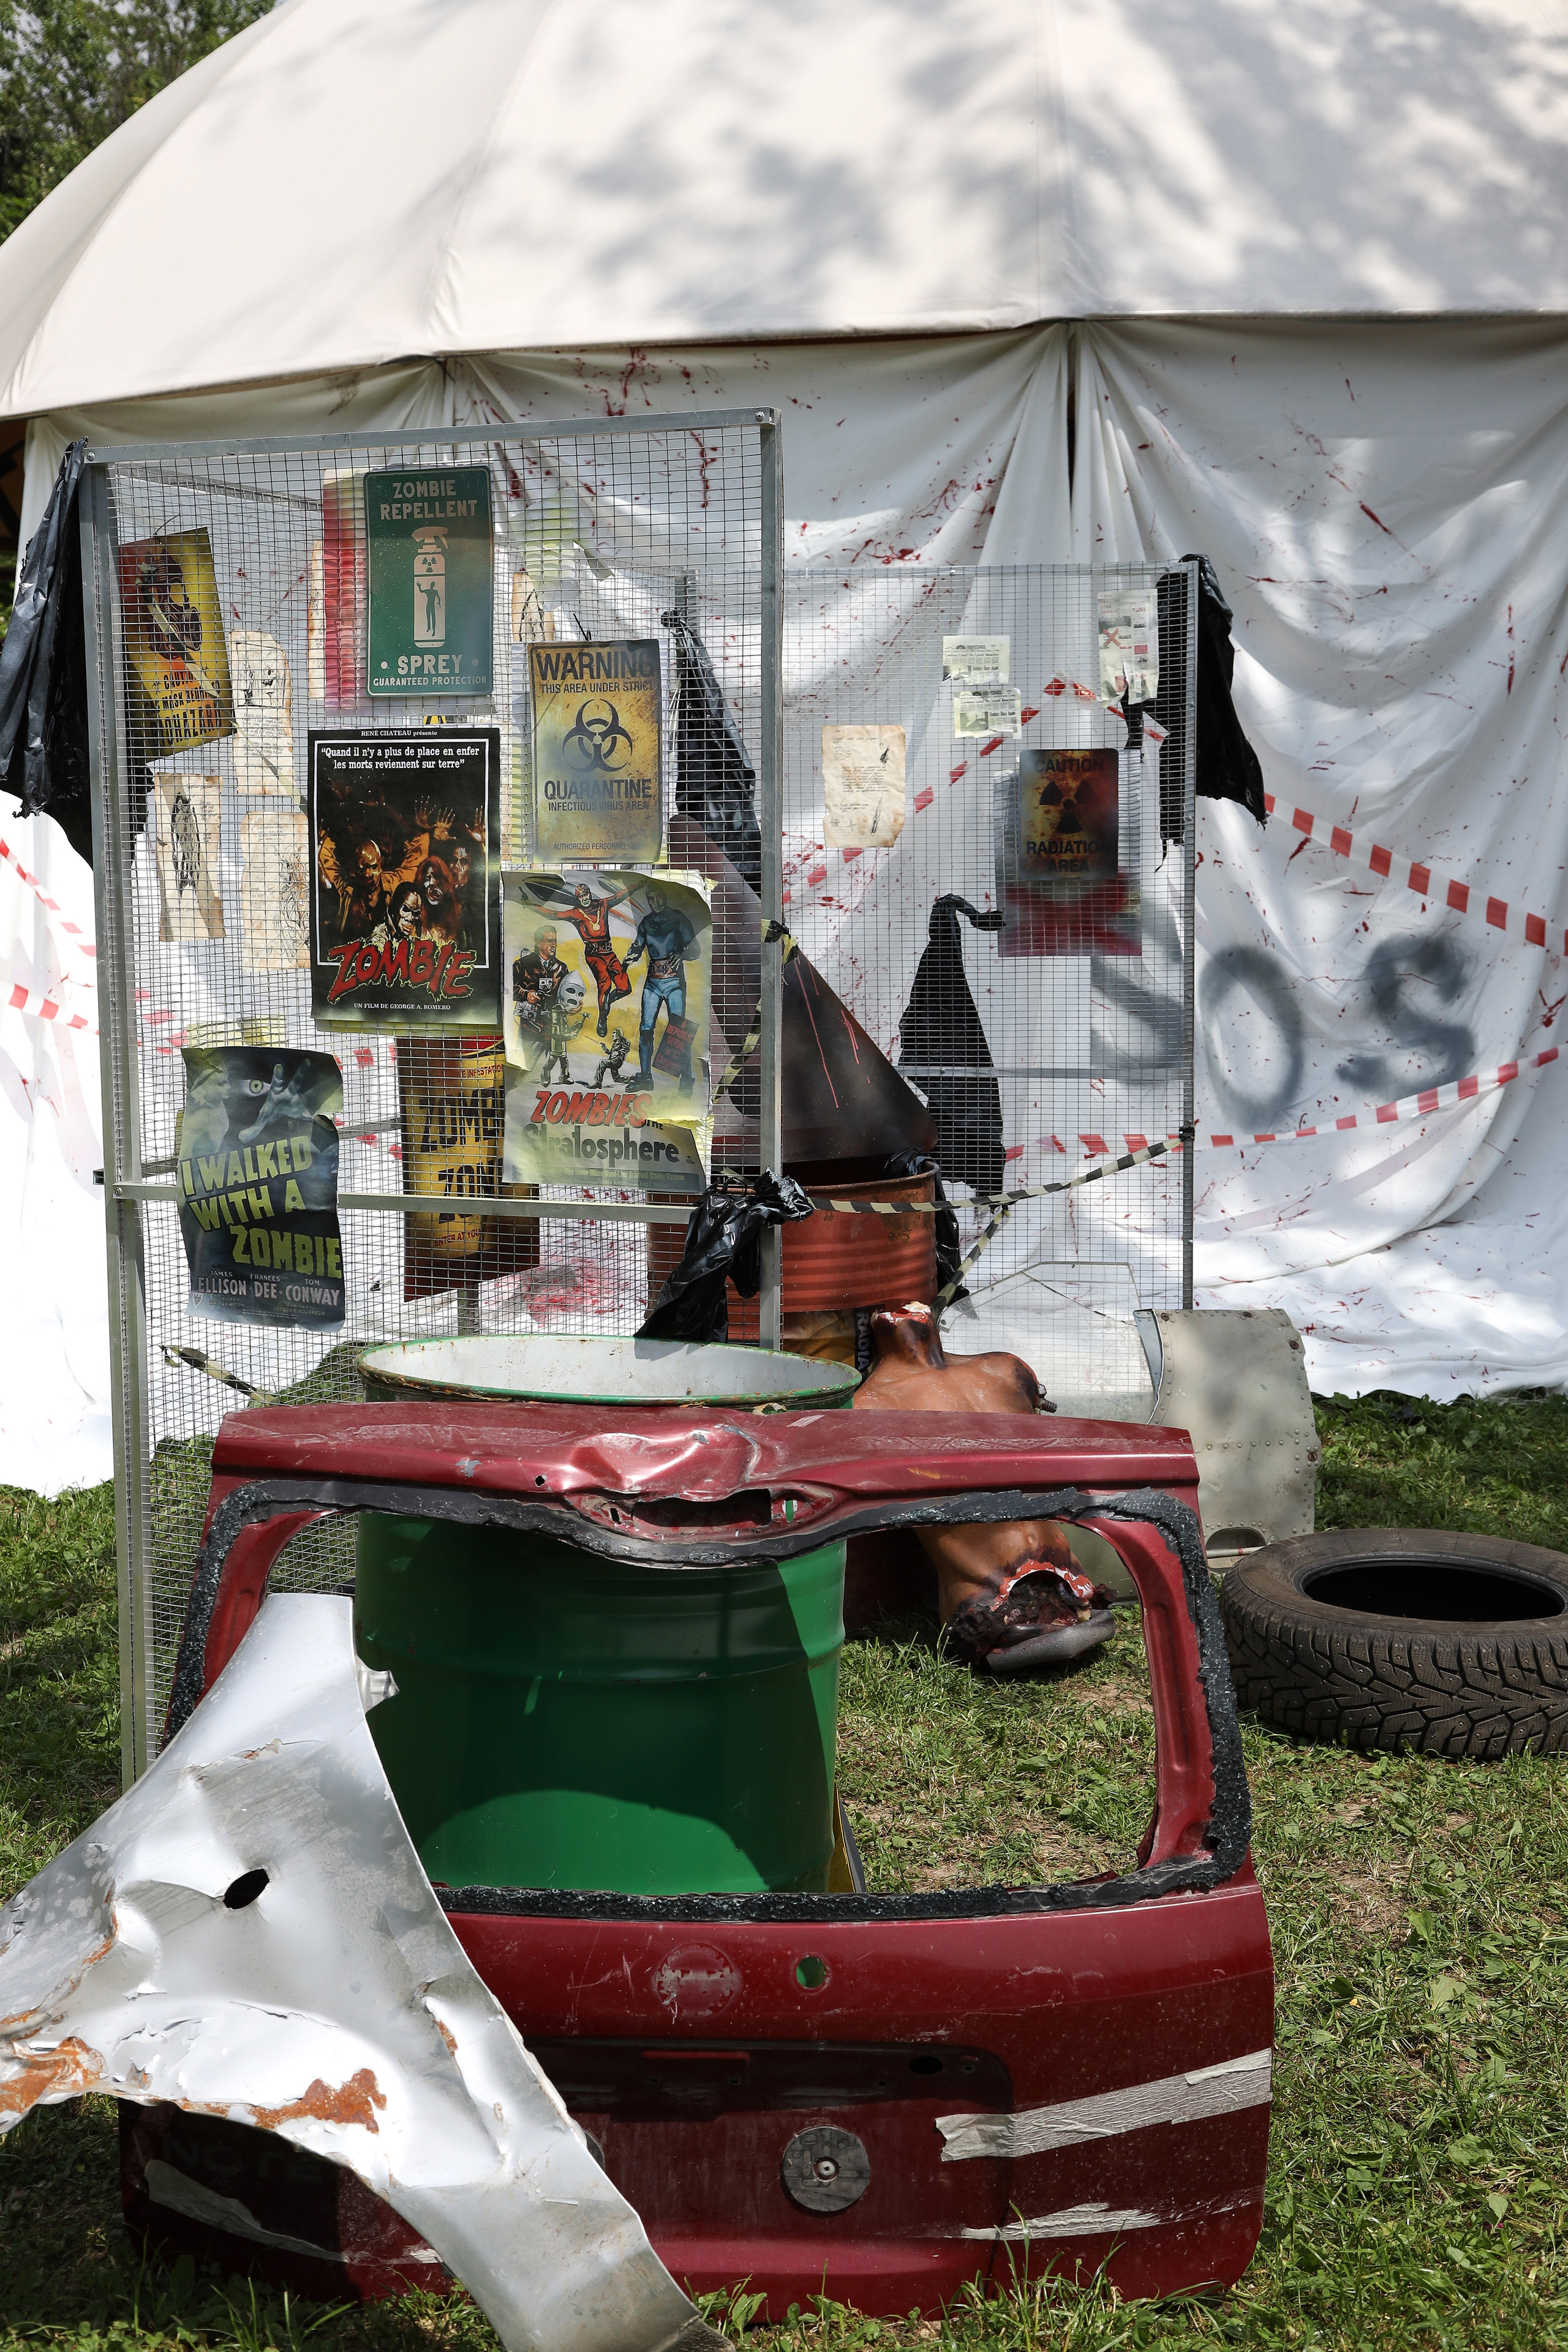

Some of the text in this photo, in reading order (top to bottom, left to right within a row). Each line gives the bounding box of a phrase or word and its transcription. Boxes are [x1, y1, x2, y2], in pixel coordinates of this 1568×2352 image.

[392, 480, 456, 499] ZOMBIE
[380, 499, 477, 520] REPELLENT
[398, 654, 463, 675] SPREY
[535, 651, 654, 680] WARNING
[164, 670, 197, 690] CAUTIO
[373, 676, 487, 687] GUARANTEED PROTECTION
[540, 681, 653, 693] THIS AREA UNDER STRICT
[162, 692, 184, 710] MASK
[186, 680, 221, 704] REQUIED
[149, 702, 222, 747] BIOHAZARD
[353, 747, 360, 756] il
[385, 747, 402, 758] plus
[405, 746, 415, 756] de
[417, 746, 440, 758] place
[456, 745, 480, 756] enfer
[334, 760, 346, 769] les
[349, 760, 373, 769] morts
[375, 759, 420, 769] reviennent
[1035, 758, 1104, 774] CAUTION
[544, 778, 652, 801] QUARANTINE
[549, 801, 649, 812] INFECTIOUS VIRUS AREA
[1047, 859, 1090, 873] AREA
[327, 936, 477, 1005] ZOMBIE
[666, 1023, 695, 1043] REPUBLIC
[666, 1035, 685, 1050] SERIAL
[467, 1063, 503, 1077] INFESTATIO
[419, 1085, 504, 1153] ZOMB
[530, 1090, 653, 1128] ZOMBIES
[522, 1123, 680, 1168] Stratosphere
[181, 1135, 312, 1196] I WALKED
[190, 1179, 306, 1232] WITH A
[434, 1234, 456, 1247] ENTER
[457, 1232, 465, 1242] AT
[467, 1227, 481, 1239] YOU
[230, 1224, 342, 1279] ZOMBIE
[250, 1273, 281, 1282] FRANCES
[197, 1276, 247, 1296] ELLISON
[254, 1281, 277, 1299] DEE
[285, 1284, 340, 1306] CONWAY
[857, 1313, 870, 1371] RADIA
